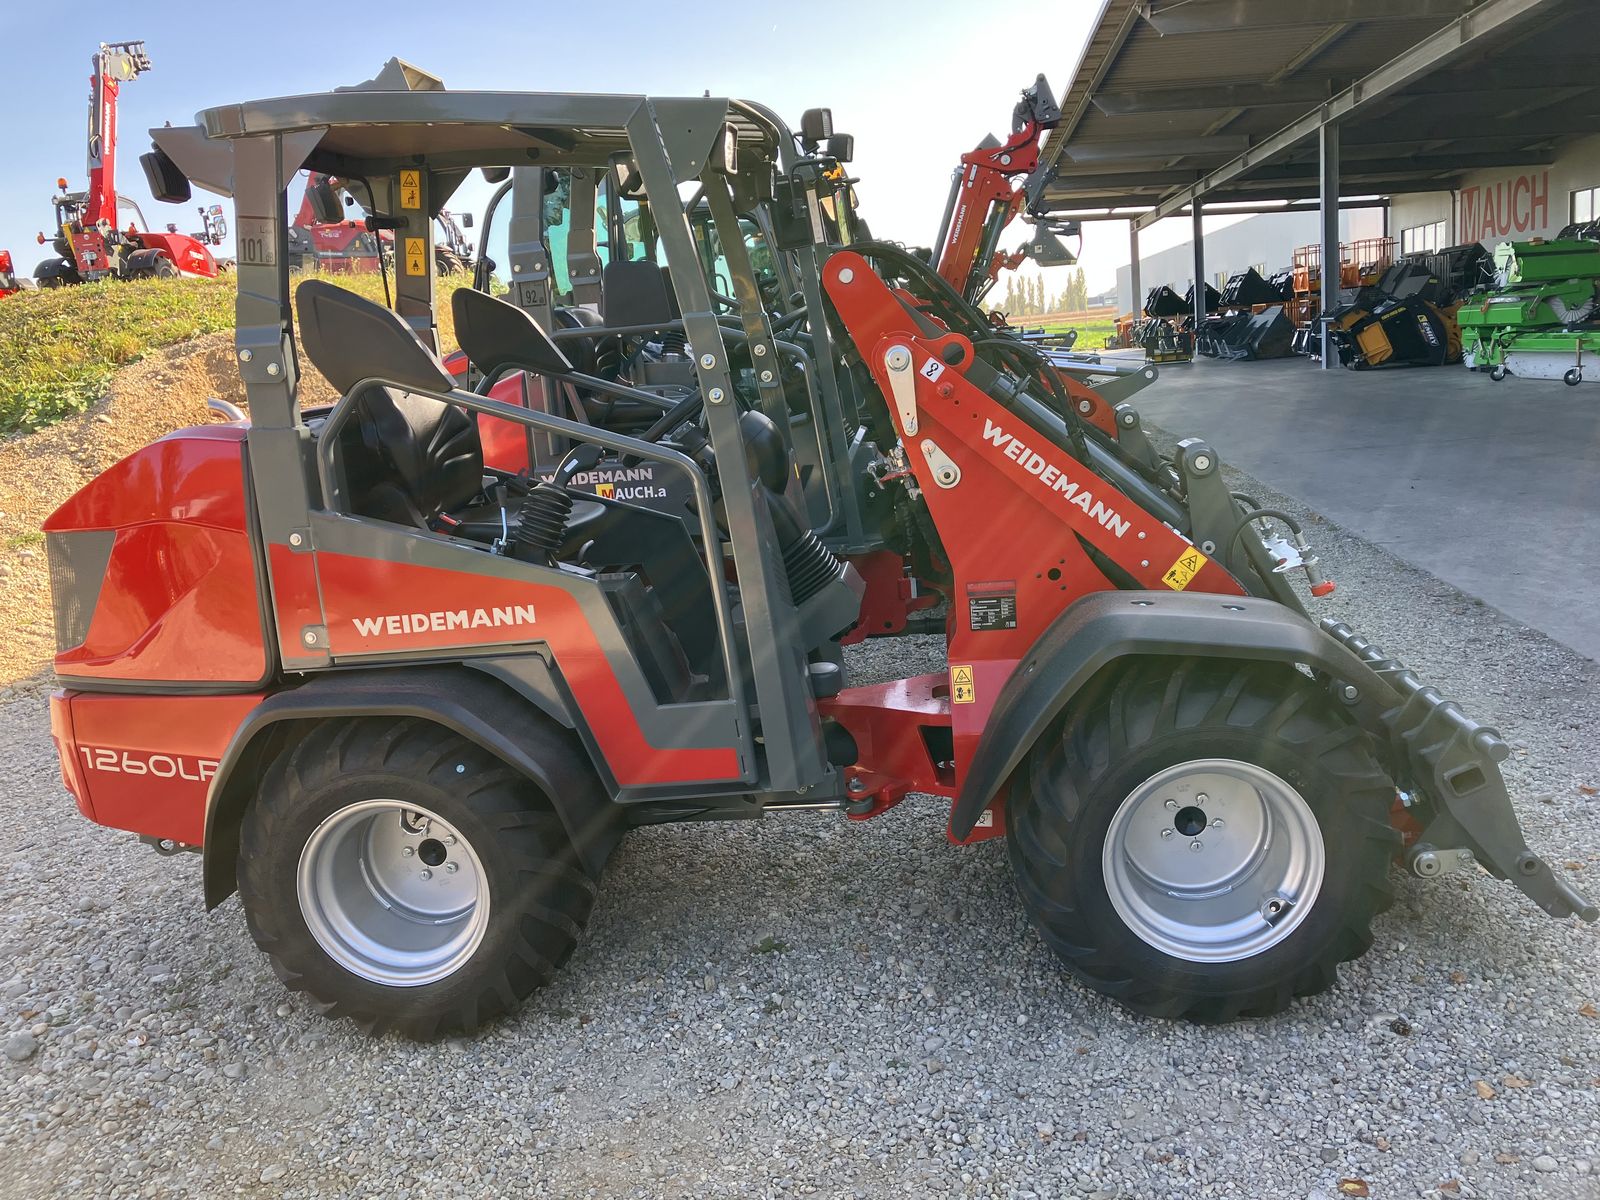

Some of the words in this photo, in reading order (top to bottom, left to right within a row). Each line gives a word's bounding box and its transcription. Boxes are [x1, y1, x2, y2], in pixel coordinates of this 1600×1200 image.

[952, 204, 967, 244] WEIDEMANN
[1461, 171, 1549, 244] MAUCH
[241, 238, 263, 262] 101
[526, 290, 537, 303] 92
[541, 468, 653, 486] WIDEMANN
[982, 418, 1131, 538] WEIDEMANN
[352, 604, 536, 637] WEIDEMANN
[80, 747, 220, 782] 1260LP
